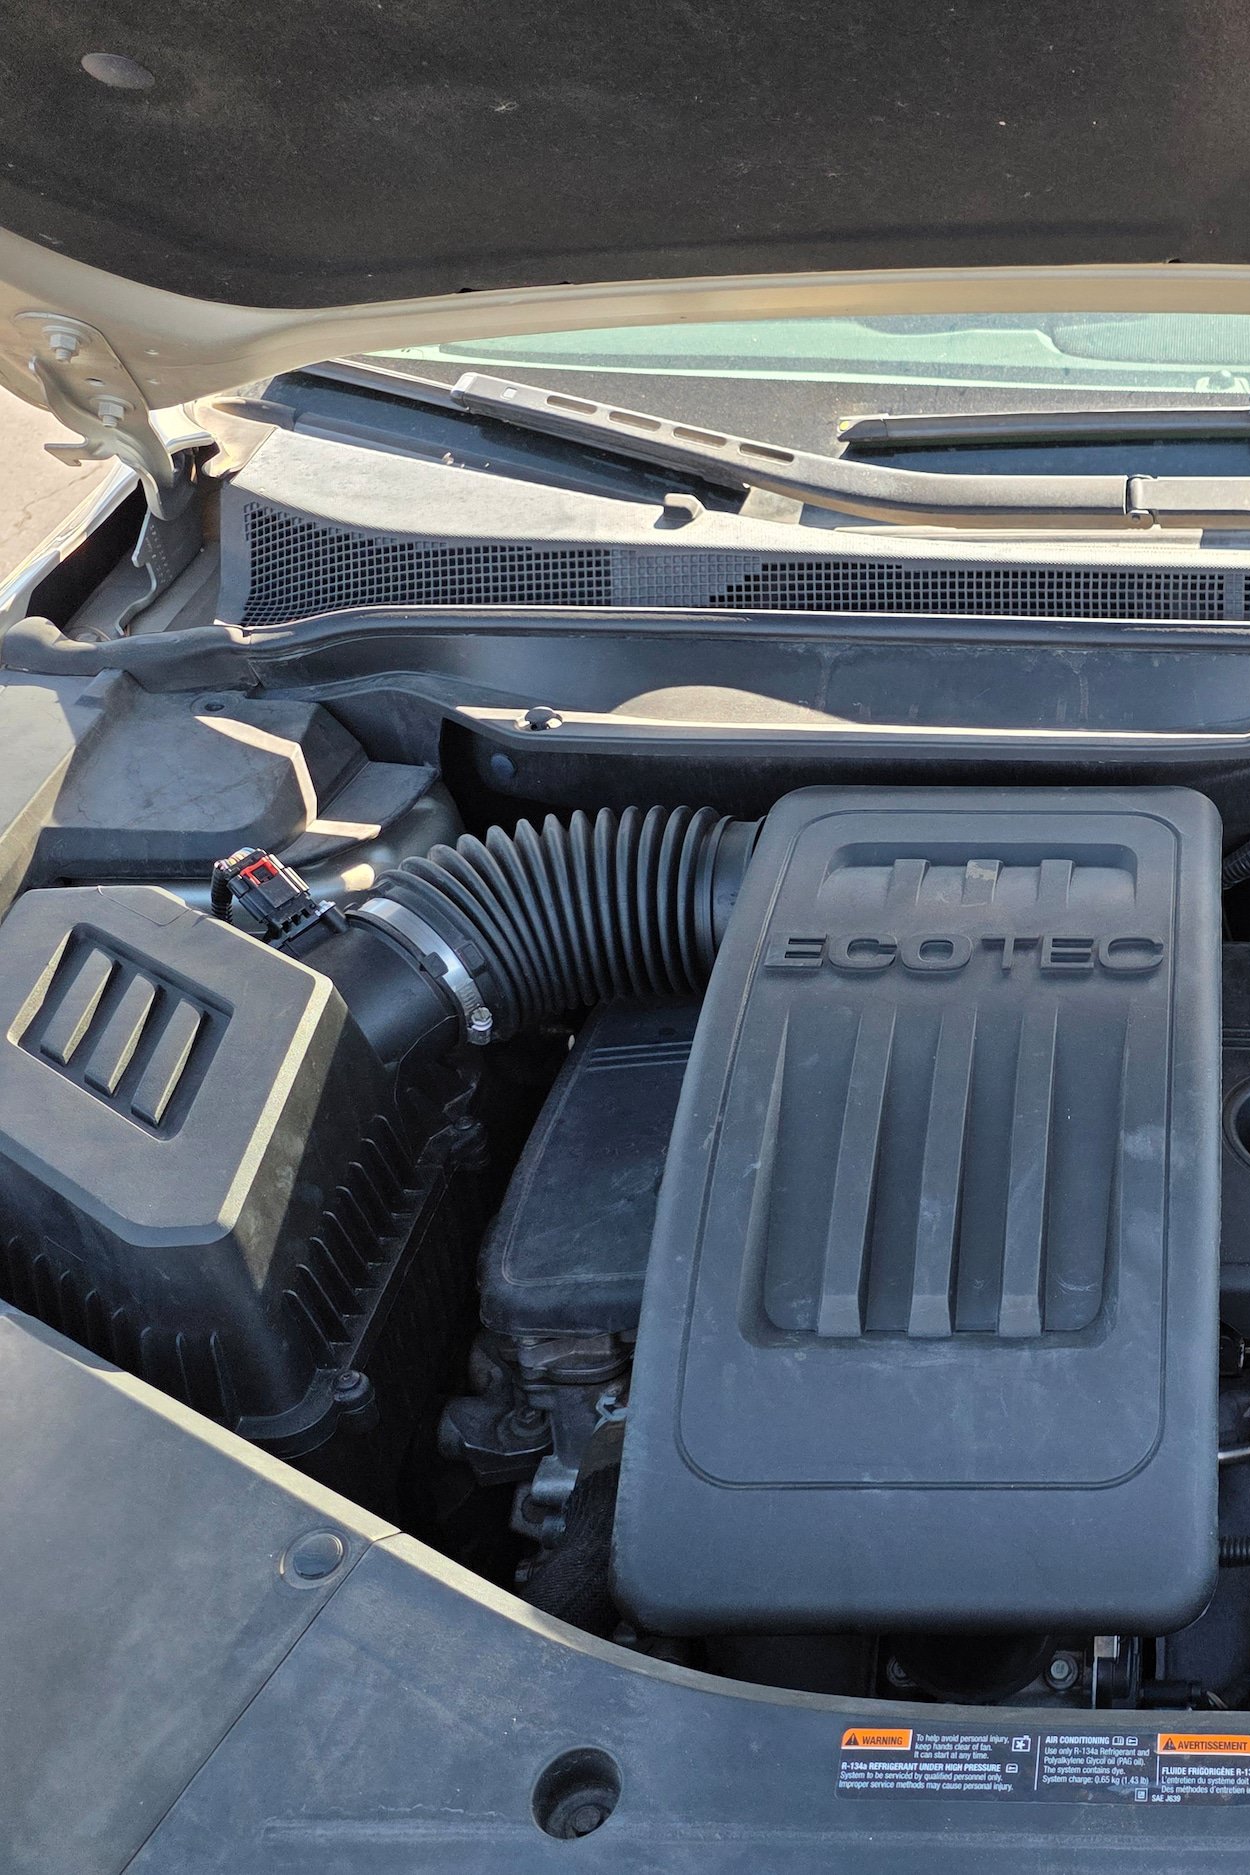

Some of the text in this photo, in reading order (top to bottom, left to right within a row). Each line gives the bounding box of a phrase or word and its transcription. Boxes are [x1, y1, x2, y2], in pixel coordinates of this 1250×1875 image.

[764, 933, 1164, 974] ECOTEC
[862, 1736, 903, 1745] WARNING
[917, 1734, 923, 1742] To
[925, 1734, 939, 1743] help
[960, 1735, 988, 1744] personal
[1045, 1736, 1109, 1745] AIR CONDITIONING
[915, 1743, 931, 1751] keep
[1178, 1742, 1247, 1750] AVERTISSEMENT
[1045, 1747, 1057, 1755] Use
[1058, 1747, 1072, 1756] only
[1099, 1748, 1135, 1758] Refrigerant
[841, 1762, 867, 1770] R-134a
[868, 1763, 917, 1771] REFRIGERANT
[918, 1763, 943, 1771] UNDER
[944, 1763, 962, 1771] HIGH
[1085, 1758, 1105, 1766] Glycol
[1116, 1758, 1132, 1767] (PAG
[1044, 1766, 1055, 1774] The
[1057, 1767, 1080, 1776] system
[1111, 1767, 1125, 1776] dye.
[1162, 1767, 1186, 1775] FLUIDE
[840, 1771, 865, 1781] System
[914, 1772, 922, 1781] by
[923, 1773, 952, 1782] qualified
[953, 1773, 985, 1782] personnel
[987, 1773, 1002, 1782] only.
[1043, 1776, 1067, 1785] System
[1068, 1776, 1092, 1785] charge:
[1094, 1776, 1109, 1784] 0.65
[1111, 1776, 1119, 1785] kg
[839, 1781, 868, 1789] Improper
[895, 1781, 924, 1789] methods
[963, 1782, 991, 1791] personal
[993, 1783, 1013, 1791] injury.
[1207, 1777, 1234, 1786] système
[1236, 1777, 1248, 1785] doit
[1162, 1785, 1174, 1793] Des
